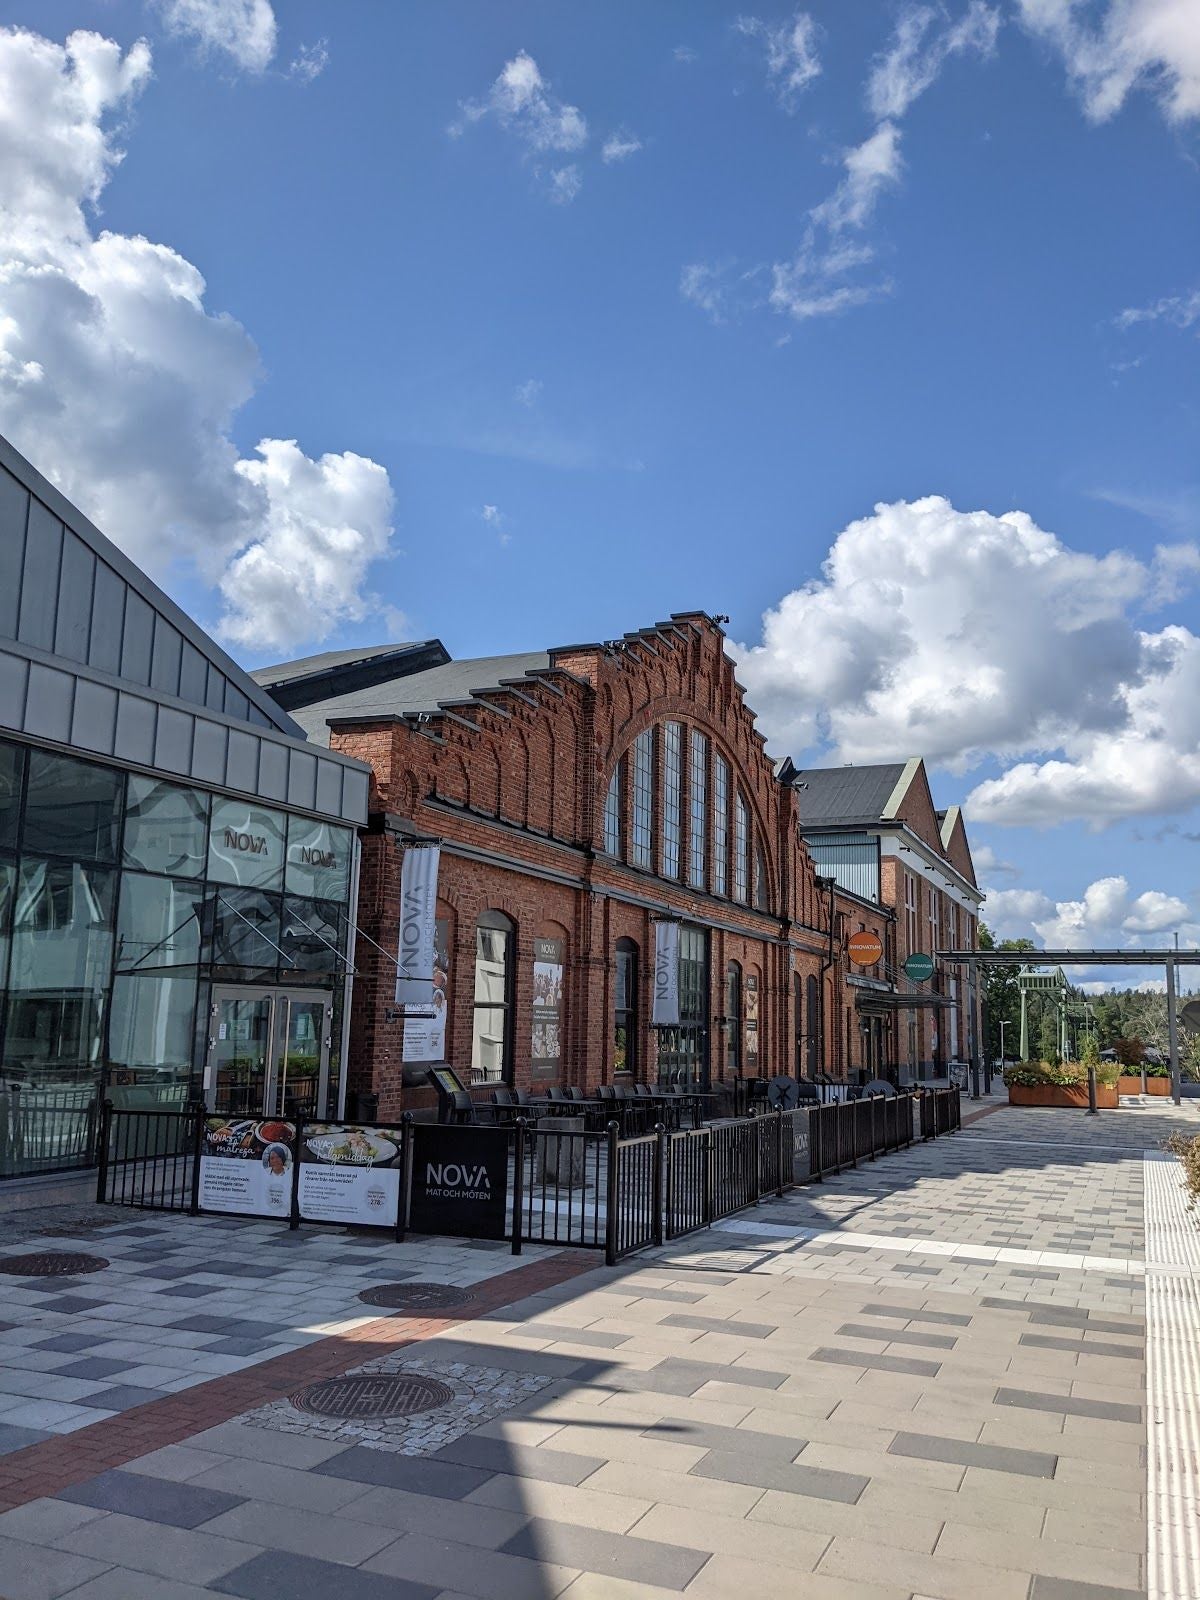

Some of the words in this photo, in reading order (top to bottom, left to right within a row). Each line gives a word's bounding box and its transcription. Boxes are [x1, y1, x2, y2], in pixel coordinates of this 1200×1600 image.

[224, 829, 268, 856] NOVA
[301, 846, 337, 869] NOVA
[401, 885, 424, 968] NOVA
[424, 922, 433, 944] OCH
[424, 946, 433, 967] MAT
[655, 947, 670, 1000] NOVA
[427, 1162, 491, 1189] NOVA
[426, 1188, 443, 1196] MAT
[443, 1189, 460, 1198] OCH
[461, 1190, 491, 1200] MÖTEN
